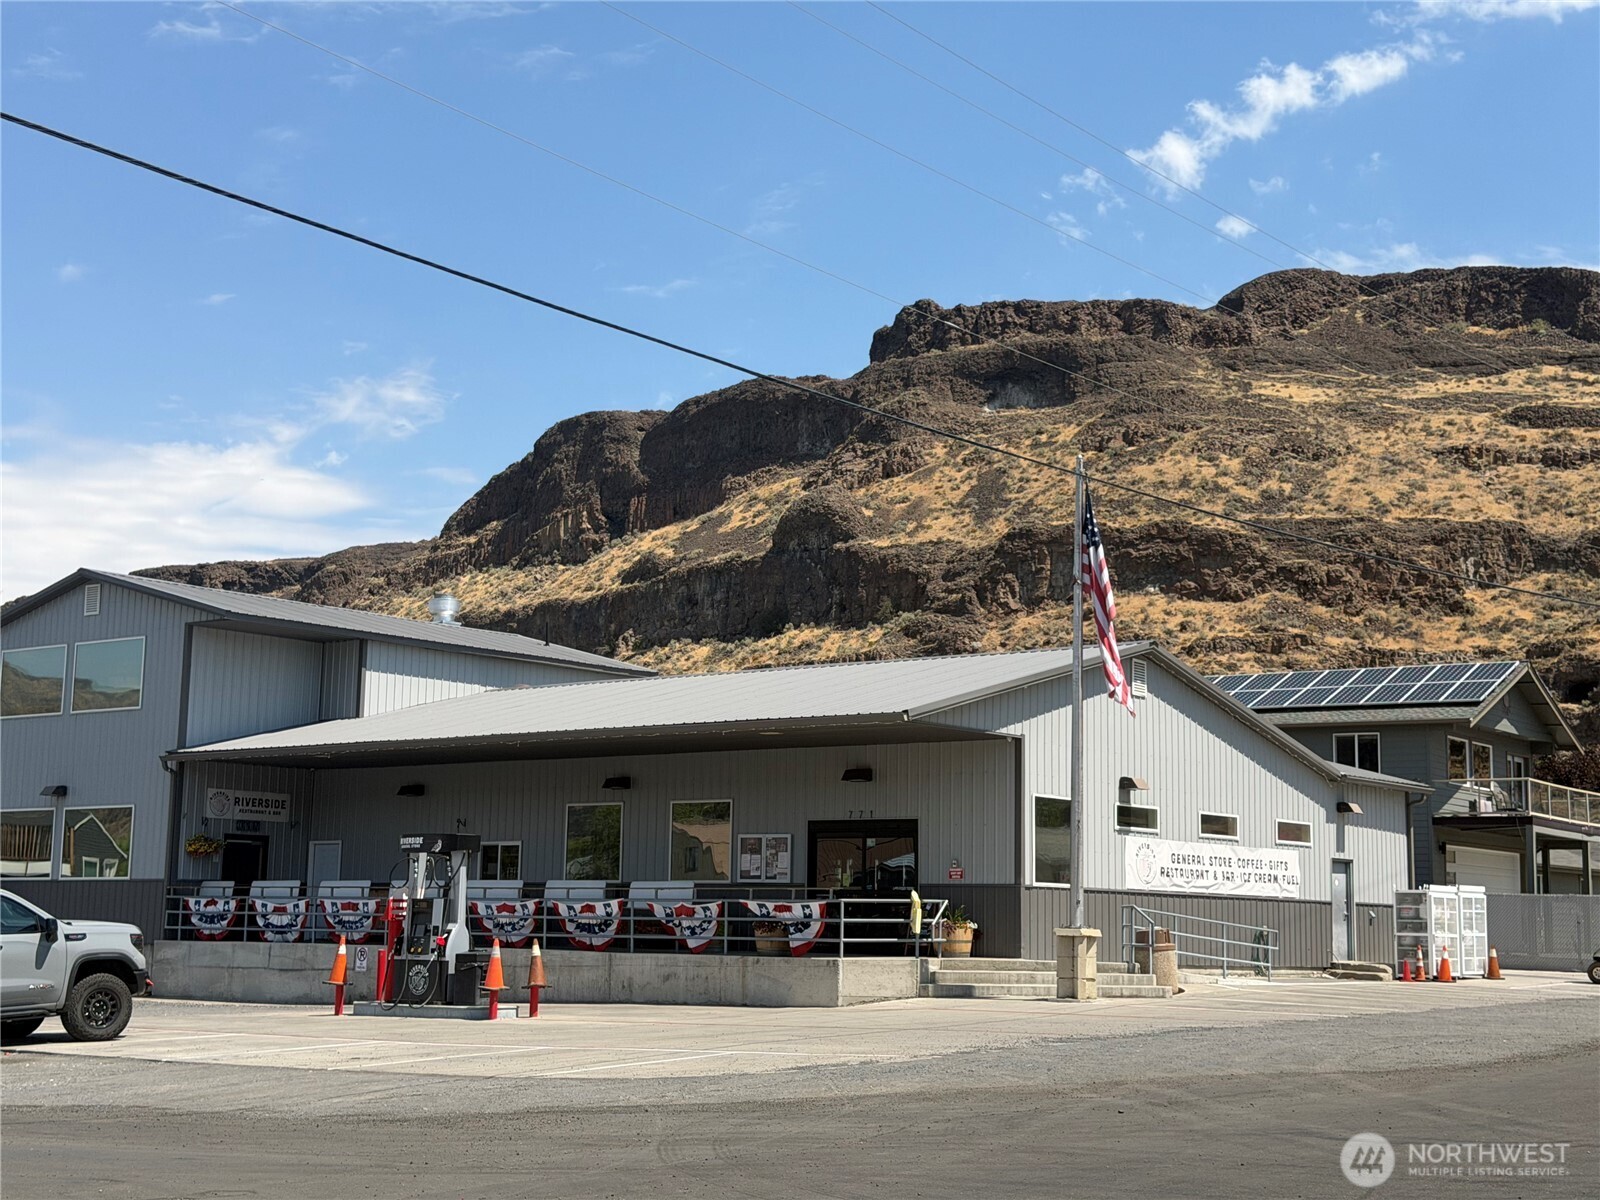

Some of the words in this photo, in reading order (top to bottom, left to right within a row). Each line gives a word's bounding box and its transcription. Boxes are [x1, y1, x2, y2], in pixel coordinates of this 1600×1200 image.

[234, 797, 287, 809] RIVERSIDE
[848, 810, 873, 819] 771
[1171, 853, 1205, 866] GENERAL
[1209, 856, 1232, 868] STORE
[1237, 858, 1263, 869] COFFEE
[1269, 860, 1288, 871] GIFTS
[1160, 867, 1209, 880] RESTAURANT
[1213, 870, 1218, 881] &
[1240, 873, 1252, 883] ICE
[1254, 873, 1278, 884] CREAM
[1282, 875, 1299, 885] FUEL
